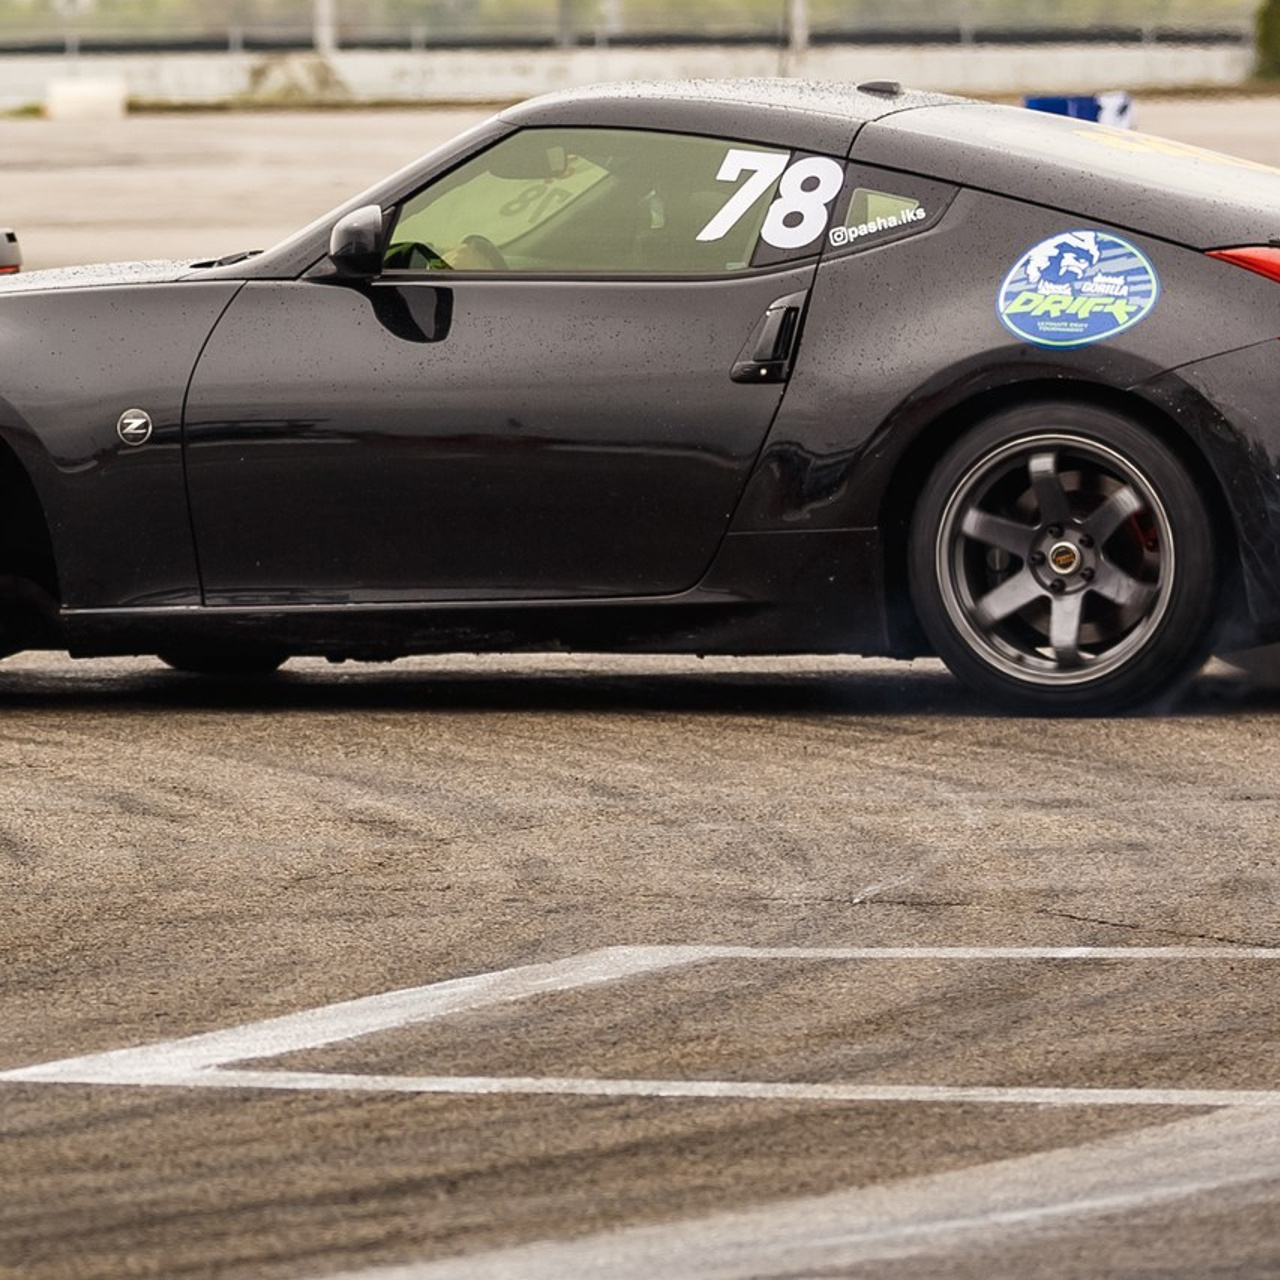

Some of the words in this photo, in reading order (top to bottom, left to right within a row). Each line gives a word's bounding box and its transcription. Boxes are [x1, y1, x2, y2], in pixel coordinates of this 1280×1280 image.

[696, 149, 844, 249] 78
[1081, 282, 1129, 297] GORILLA
[1005, 291, 1138, 325] DRIFT
[122, 418, 147, 434] Z
